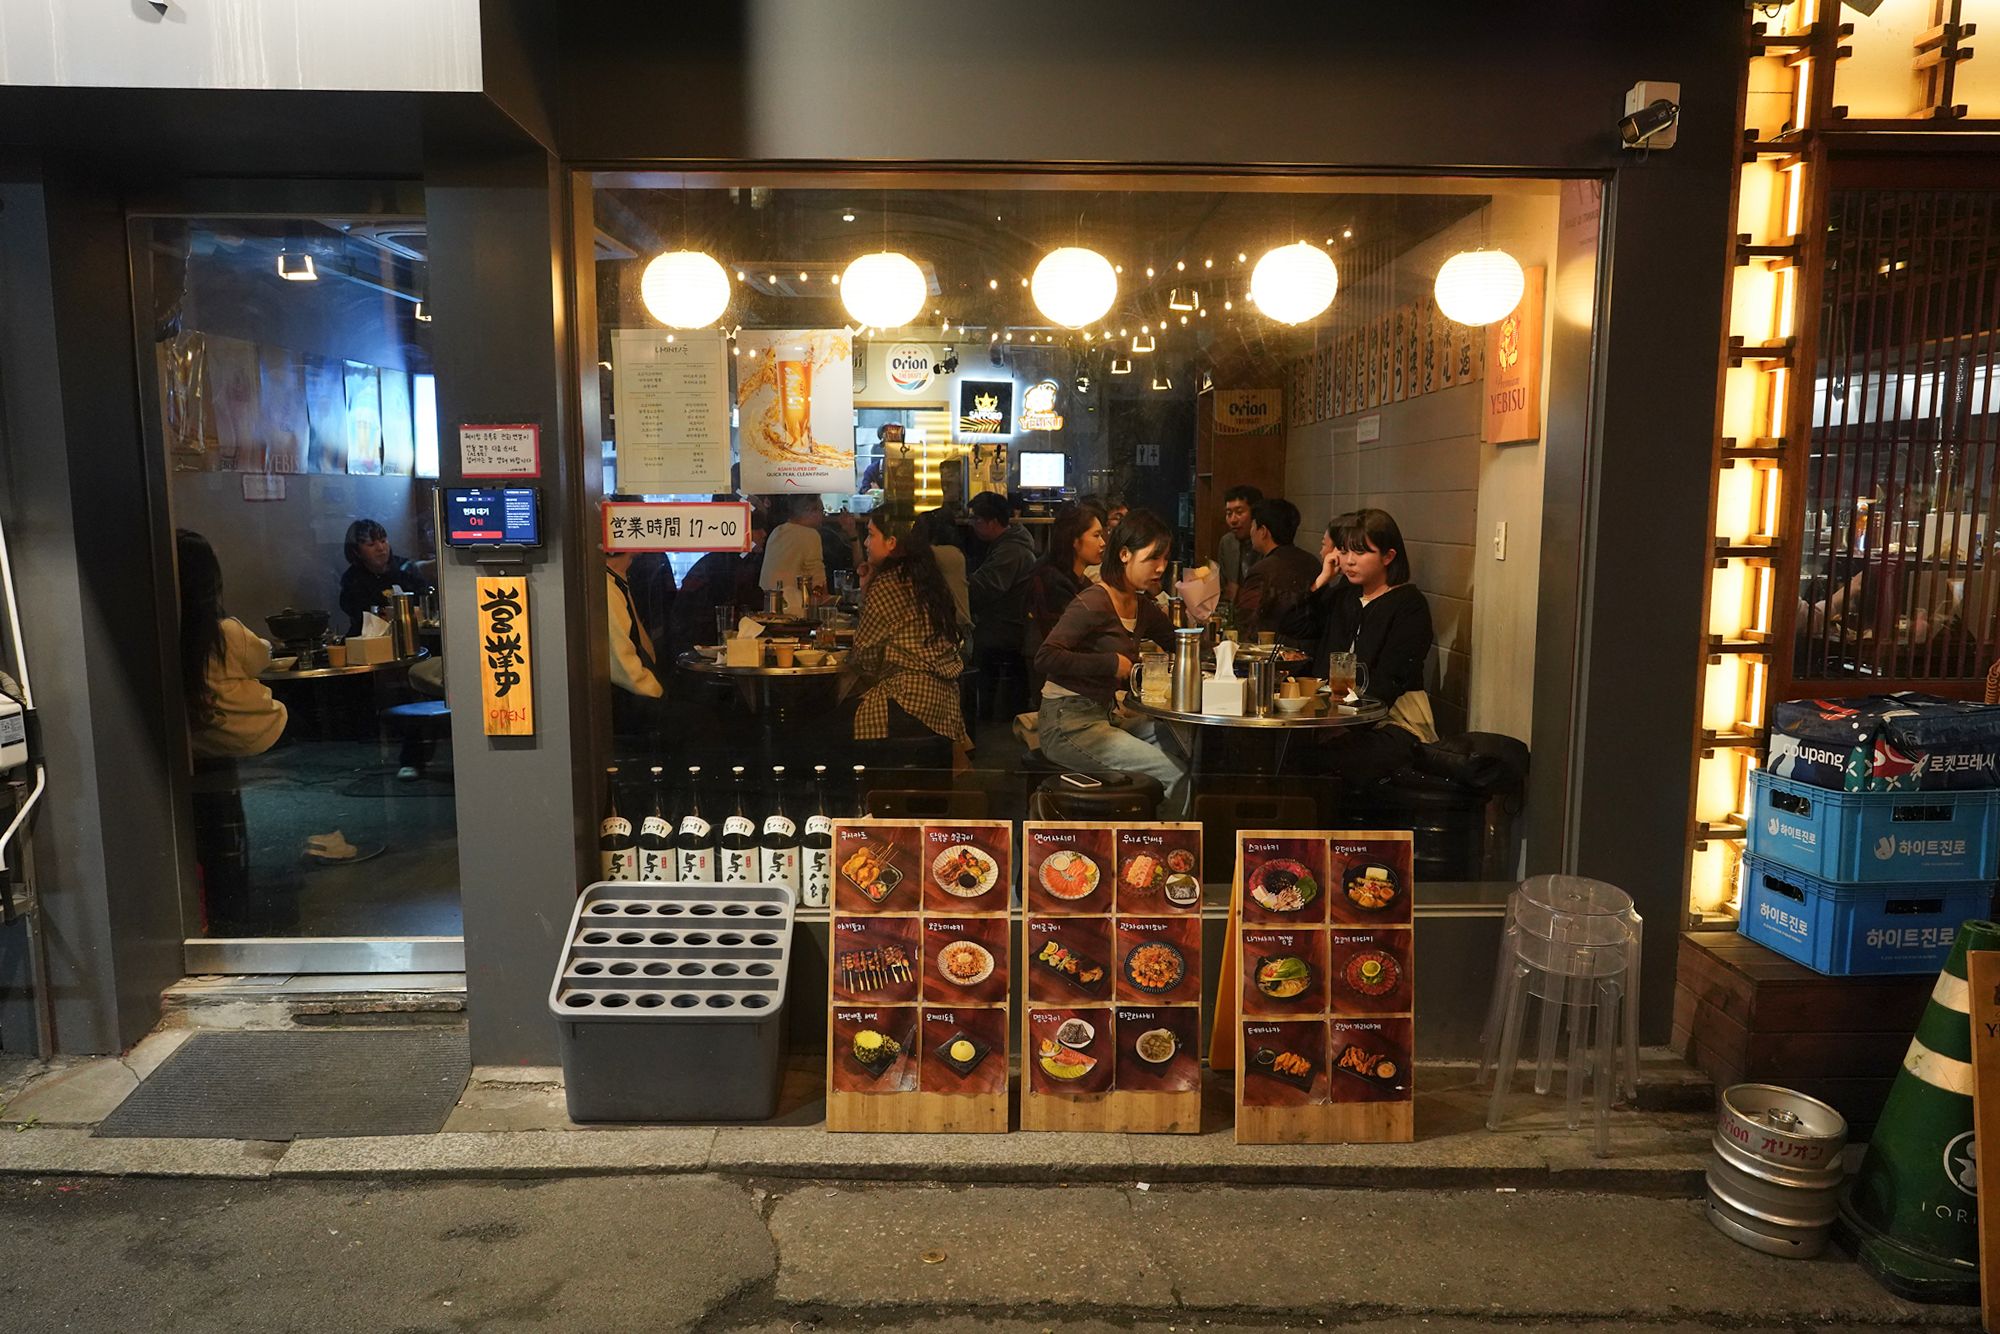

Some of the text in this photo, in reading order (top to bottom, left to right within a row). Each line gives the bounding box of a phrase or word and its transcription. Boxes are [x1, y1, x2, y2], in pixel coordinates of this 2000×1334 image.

[892, 355, 928, 370] Orion
[1229, 401, 1267, 416] Orion
[1490, 387, 1526, 415] YEBISU
[969, 409, 1003, 420] SAPPORO
[610, 516, 681, 539] 営業時間
[490, 707, 526, 729] OPEN
[1783, 743, 1845, 771] coupang
[1929, 753, 1996, 773] 로켓프레시
[1034, 833, 1076, 844] 연어사시미
[1780, 823, 1817, 845] 하이트진로
[1248, 843, 1280, 852] 스키야키
[1899, 839, 1966, 856] 하이트진로
[1031, 922, 1061, 932] 메로구이
[1760, 902, 1808, 937] 하이트진로
[1866, 927, 1955, 949] 하이트진로
[1033, 1013, 1061, 1023] 명란구이
[1119, 1011, 1155, 1021] 타코와사비
[1761, 1136, 1824, 1160] オリオン
